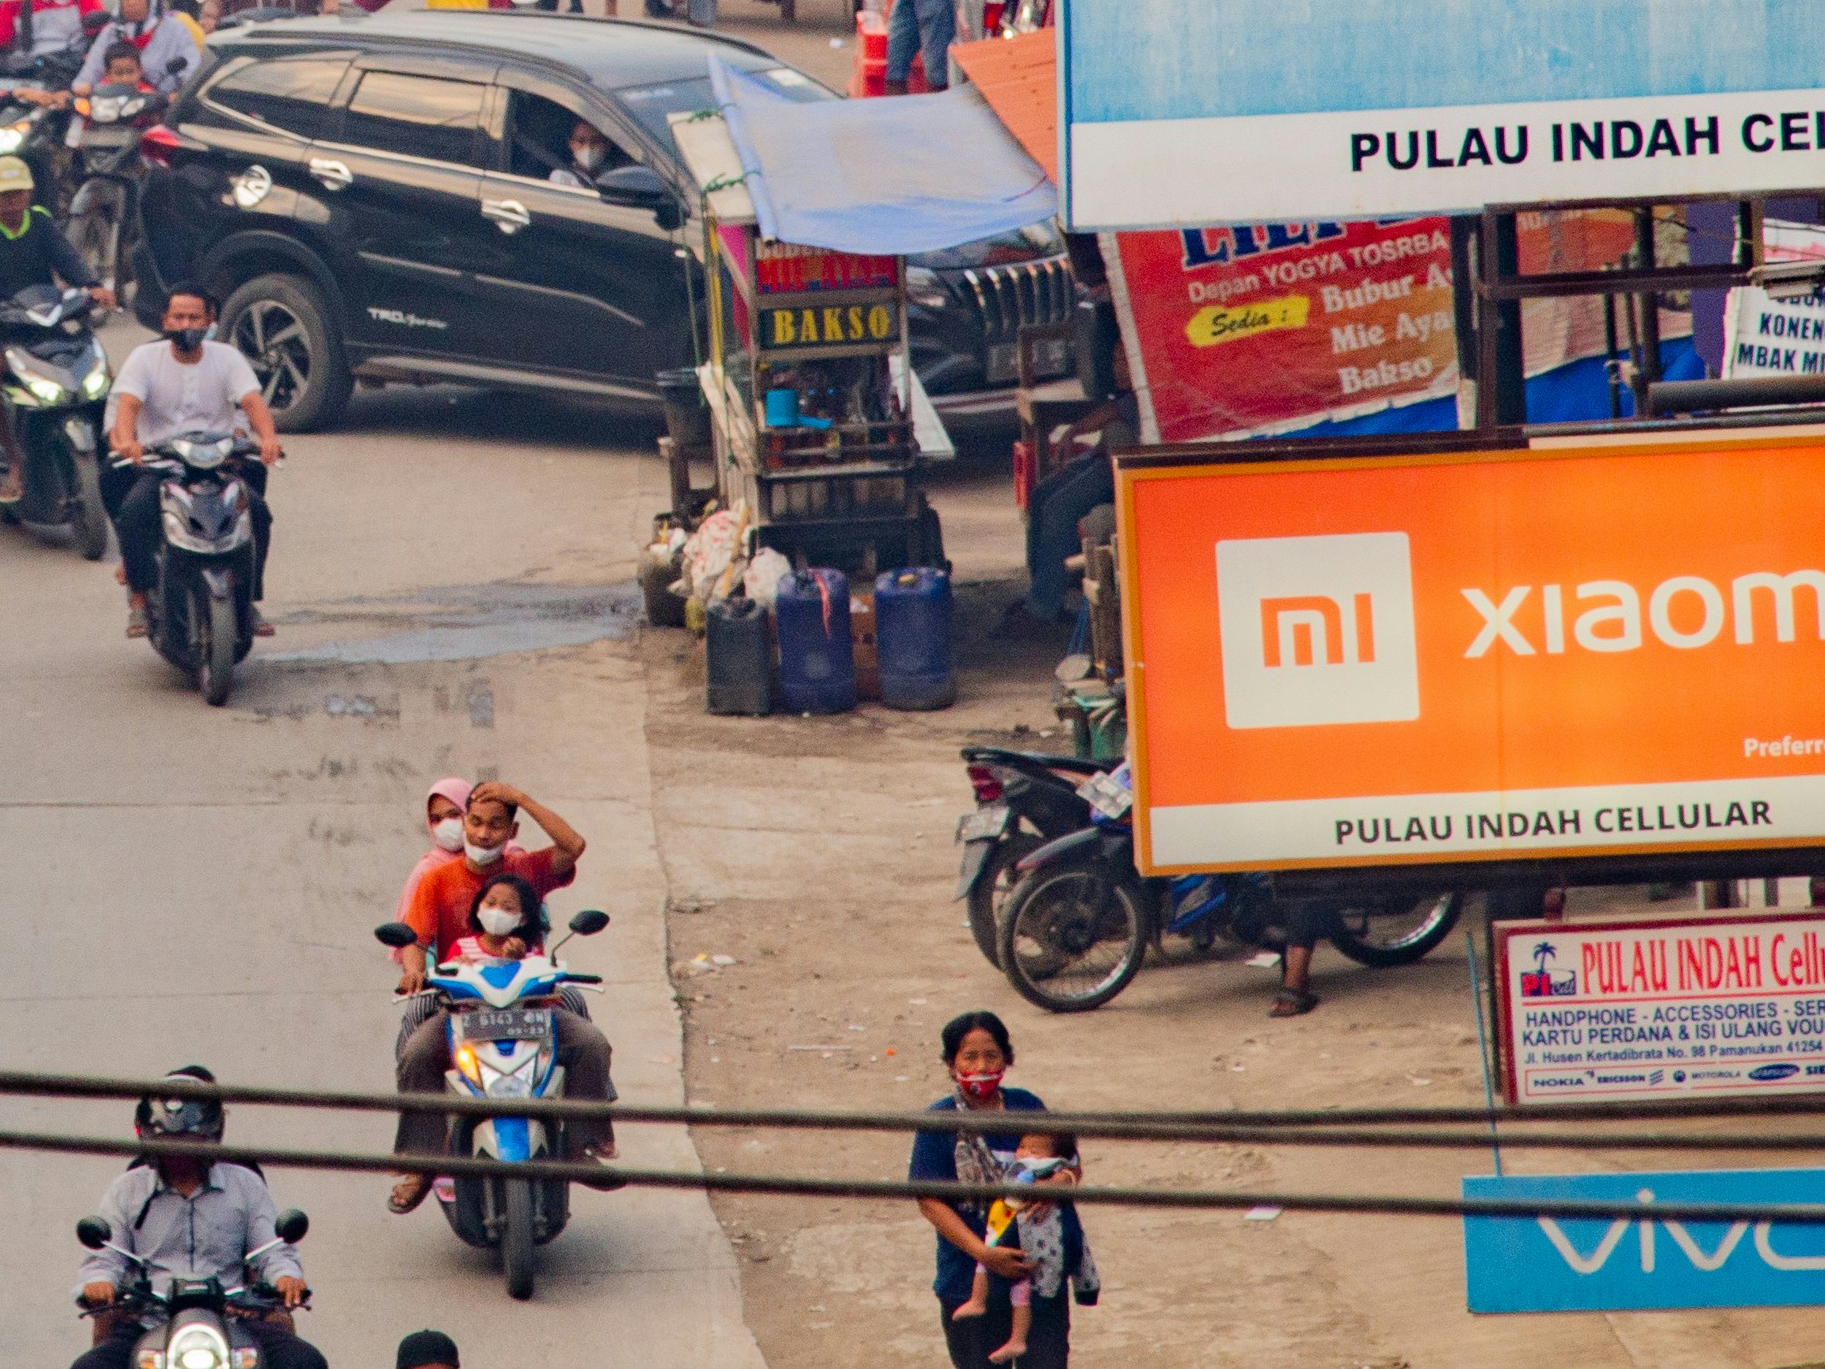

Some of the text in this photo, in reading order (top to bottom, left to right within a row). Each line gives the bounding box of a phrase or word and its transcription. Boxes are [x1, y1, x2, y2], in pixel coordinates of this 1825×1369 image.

[1351, 124, 1529, 172] PULAU
[1551, 115, 1721, 164] INDAH
[1187, 275, 1261, 303] Depan
[1264, 254, 1347, 288] YOGYA
[1320, 275, 1415, 313] Bubur
[774, 305, 890, 344] BAKSO
[1211, 309, 1271, 337] Sedia
[1331, 322, 1386, 355] Mie
[1737, 342, 1795, 371] MBAK
[1339, 356, 1434, 395] Bakso
[1335, 799, 1773, 846] PULAU INDAH CELLULAR
[1581, 932, 1825, 995] PULAU INDAH Cell
[1526, 1008, 1637, 1027] HANDPHONE
[1652, 1002, 1778, 1023] ACCESSORIES
[1523, 1029, 1582, 1046] KARTU
[1588, 1026, 1673, 1044] PERDANA
[1678, 1025, 1690, 1041] &
[1695, 1024, 1716, 1040] ISI
[1721, 1020, 1782, 1039] ULANG
[1542, 1050, 1583, 1064] Husen
[1587, 1047, 1663, 1064] Kertadibrata
[1667, 1046, 1688, 1058] No.
[1710, 1042, 1783, 1057] Pamanukan
[1786, 1040, 1823, 1054] 41254
[1533, 1077, 1585, 1088] NOKIA
[1597, 1075, 1646, 1084] ERICSSON
